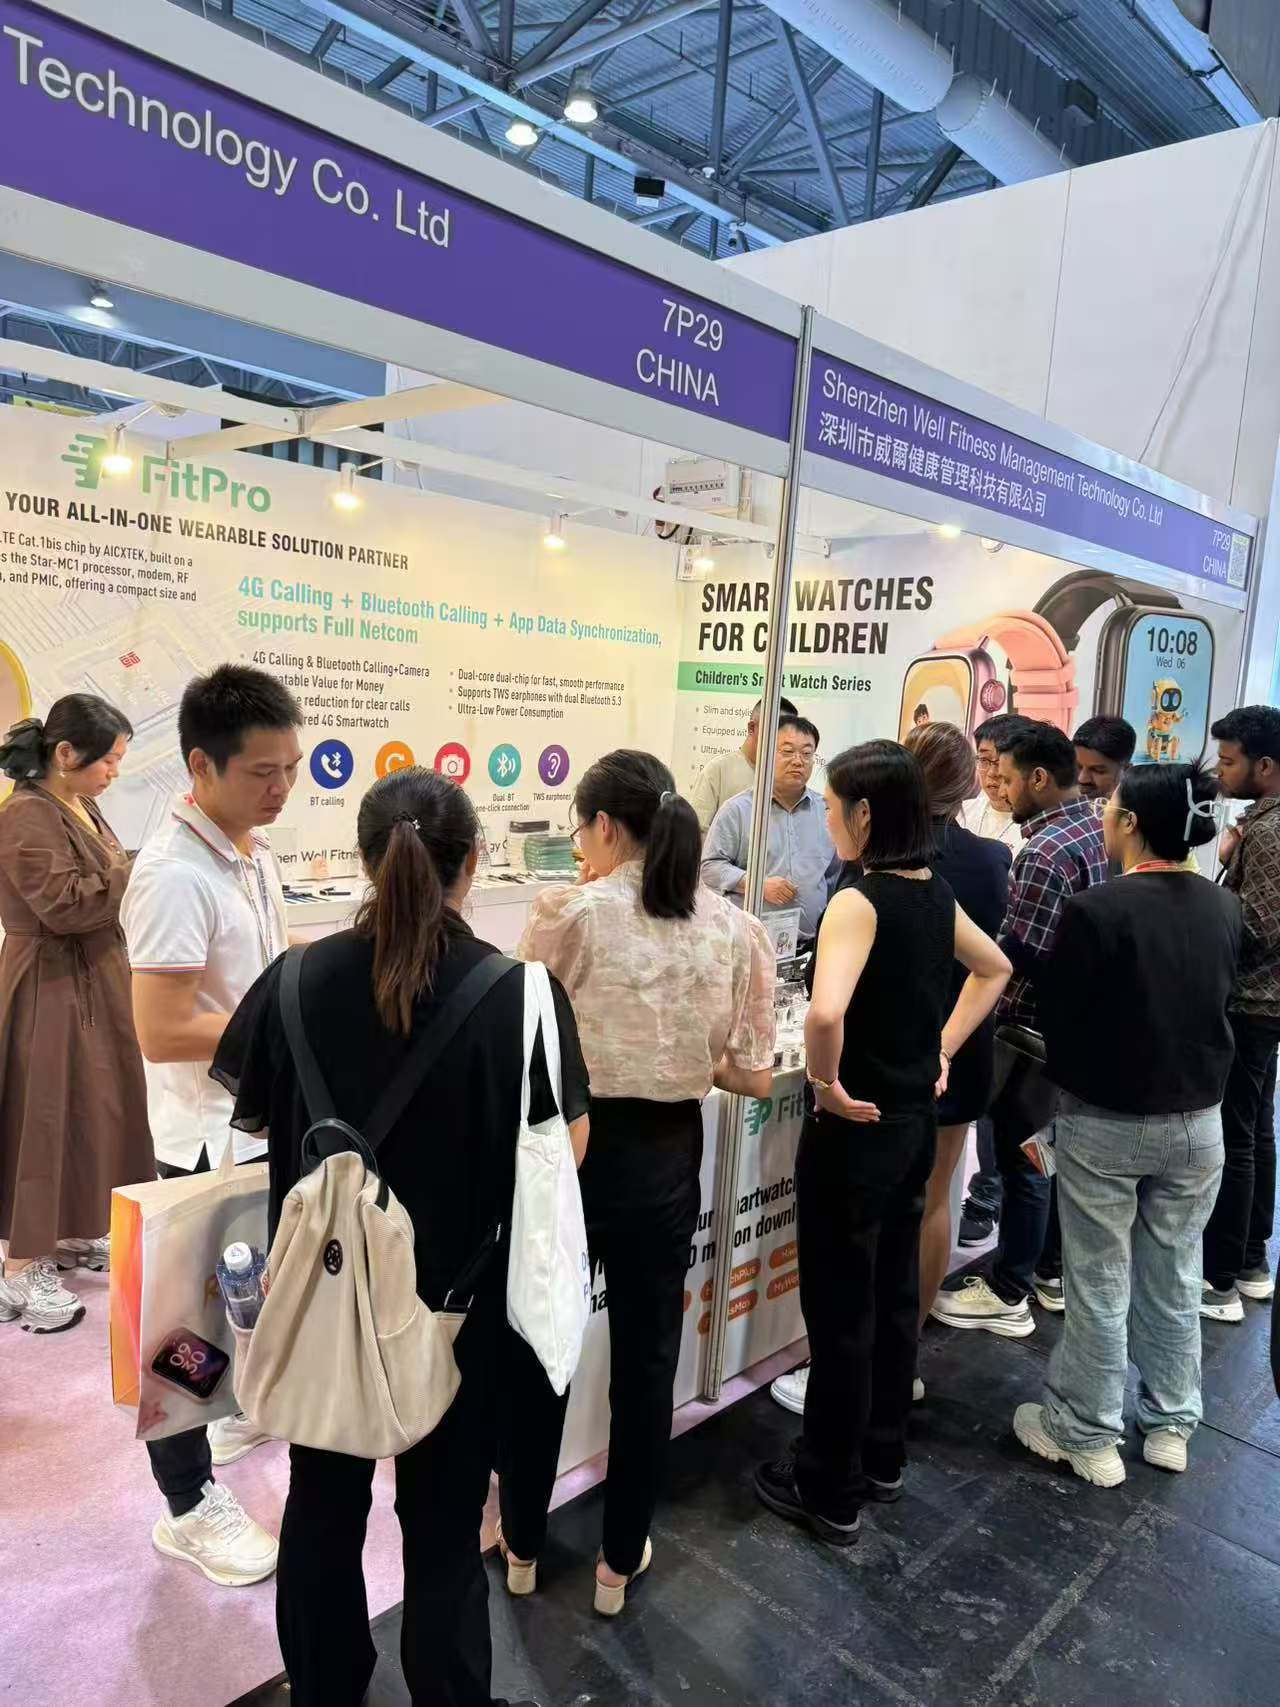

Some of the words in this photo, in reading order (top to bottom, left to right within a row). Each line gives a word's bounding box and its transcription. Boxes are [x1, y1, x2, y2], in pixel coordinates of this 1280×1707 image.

[4, 25, 297, 195] Technology
[312, 158, 379, 221] Co.
[396, 189, 449, 248] Ltd
[662, 298, 723, 353] 7P29
[636, 348, 719, 407] CHINA
[822, 368, 907, 427] Shenzhen
[913, 405, 945, 441] Well
[949, 421, 997, 461] Fitness
[1000, 442, 1075, 492] Management
[1077, 472, 1131, 518] Technology
[1132, 497, 1147, 520] Co.
[1149, 503, 1163, 526] Ltd
[818, 411, 1047, 518] 深圳市威爾健康管理科技有限公司
[142, 455, 272, 512] FitPro
[6, 491, 60, 518] YOUR
[67, 501, 172, 534] ALL-IN-ONE
[178, 518, 266, 548] WEARABLE
[271, 533, 343, 560] SOLUTION
[348, 546, 408, 571] PARTNER
[1212, 529, 1231, 552] 7P29
[0, 531, 15, 545] TE
[18, 533, 62, 551] Cat.1bis
[64, 540, 86, 555] chip
[89, 543, 101, 557] by
[150, 551, 172, 566] built
[174, 556, 185, 566] on
[187, 558, 193, 567] a
[10, 551, 28, 565] the
[30, 555, 79, 571] Star-MC1
[82, 561, 135, 580] processor,
[138, 568, 175, 584] modem,
[177, 571, 190, 583] RF
[1202, 555, 1228, 578] CHINA
[9, 571, 28, 584] and
[31, 573, 62, 589] PMIC,
[65, 577, 105, 594] offering
[108, 584, 114, 592] a
[116, 584, 157, 600] compact
[159, 588, 178, 600] size
[180, 591, 197, 602] and
[701, 582, 770, 613] SMAR
[794, 576, 934, 612] WATCHES
[238, 575, 264, 599] 4G
[270, 579, 333, 611] Calling
[341, 593, 354, 609] +
[361, 591, 434, 619] Bluetooth
[440, 602, 488, 630] Calling
[493, 613, 504, 627] +
[509, 611, 534, 635] App
[537, 615, 566, 635] Data
[570, 619, 662, 648] Synchronization,
[238, 610, 317, 634] supports
[323, 615, 354, 637] Full
[360, 622, 418, 644] Netcom
[698, 622, 745, 652] FOR
[752, 621, 889, 655] CILDREN
[1147, 626, 1198, 656] 10:08
[252, 651, 266, 664] 4G
[269, 652, 304, 670] Calling
[306, 655, 314, 668] &
[317, 656, 361, 672] Bluetooth
[363, 660, 430, 678] Calling+Camera
[1156, 655, 1173, 668] Wed
[1176, 657, 1186, 669] 06
[312, 675, 338, 690] Value
[341, 678, 353, 690] for
[356, 679, 384, 694] Money
[458, 668, 495, 683] Dual-core
[496, 671, 529, 686] dual-chip
[531, 673, 541, 685] for
[542, 675, 558, 687] fast,
[559, 678, 584, 689] smooth
[585, 679, 625, 691] performance
[695, 671, 748, 687] Children's
[789, 674, 828, 690] Watch
[832, 675, 872, 692] Series
[305, 695, 349, 708] reduction
[351, 697, 363, 709] for
[366, 698, 387, 711] clear
[390, 699, 411, 712] calls
[458, 686, 491, 700] Supports
[493, 688, 509, 700] TWS
[511, 690, 547, 704] earphones
[548, 691, 563, 702] with
[564, 693, 579, 704] dual
[580, 694, 611, 705] Bluetooth
[611, 695, 622, 706] 5.3
[322, 714, 334, 727] 4G
[336, 715, 389, 729] Smartwatch
[457, 703, 494, 717] Ultra-Low
[496, 705, 518, 718] Power
[519, 706, 564, 720] Consumption
[703, 706, 719, 715] Slim
[720, 707, 734, 716] and
[735, 707, 753, 718] stylis
[702, 726, 736, 737] Equipped
[737, 728, 748, 737] wit
[310, 797, 319, 806] BT
[321, 797, 344, 808] calling
